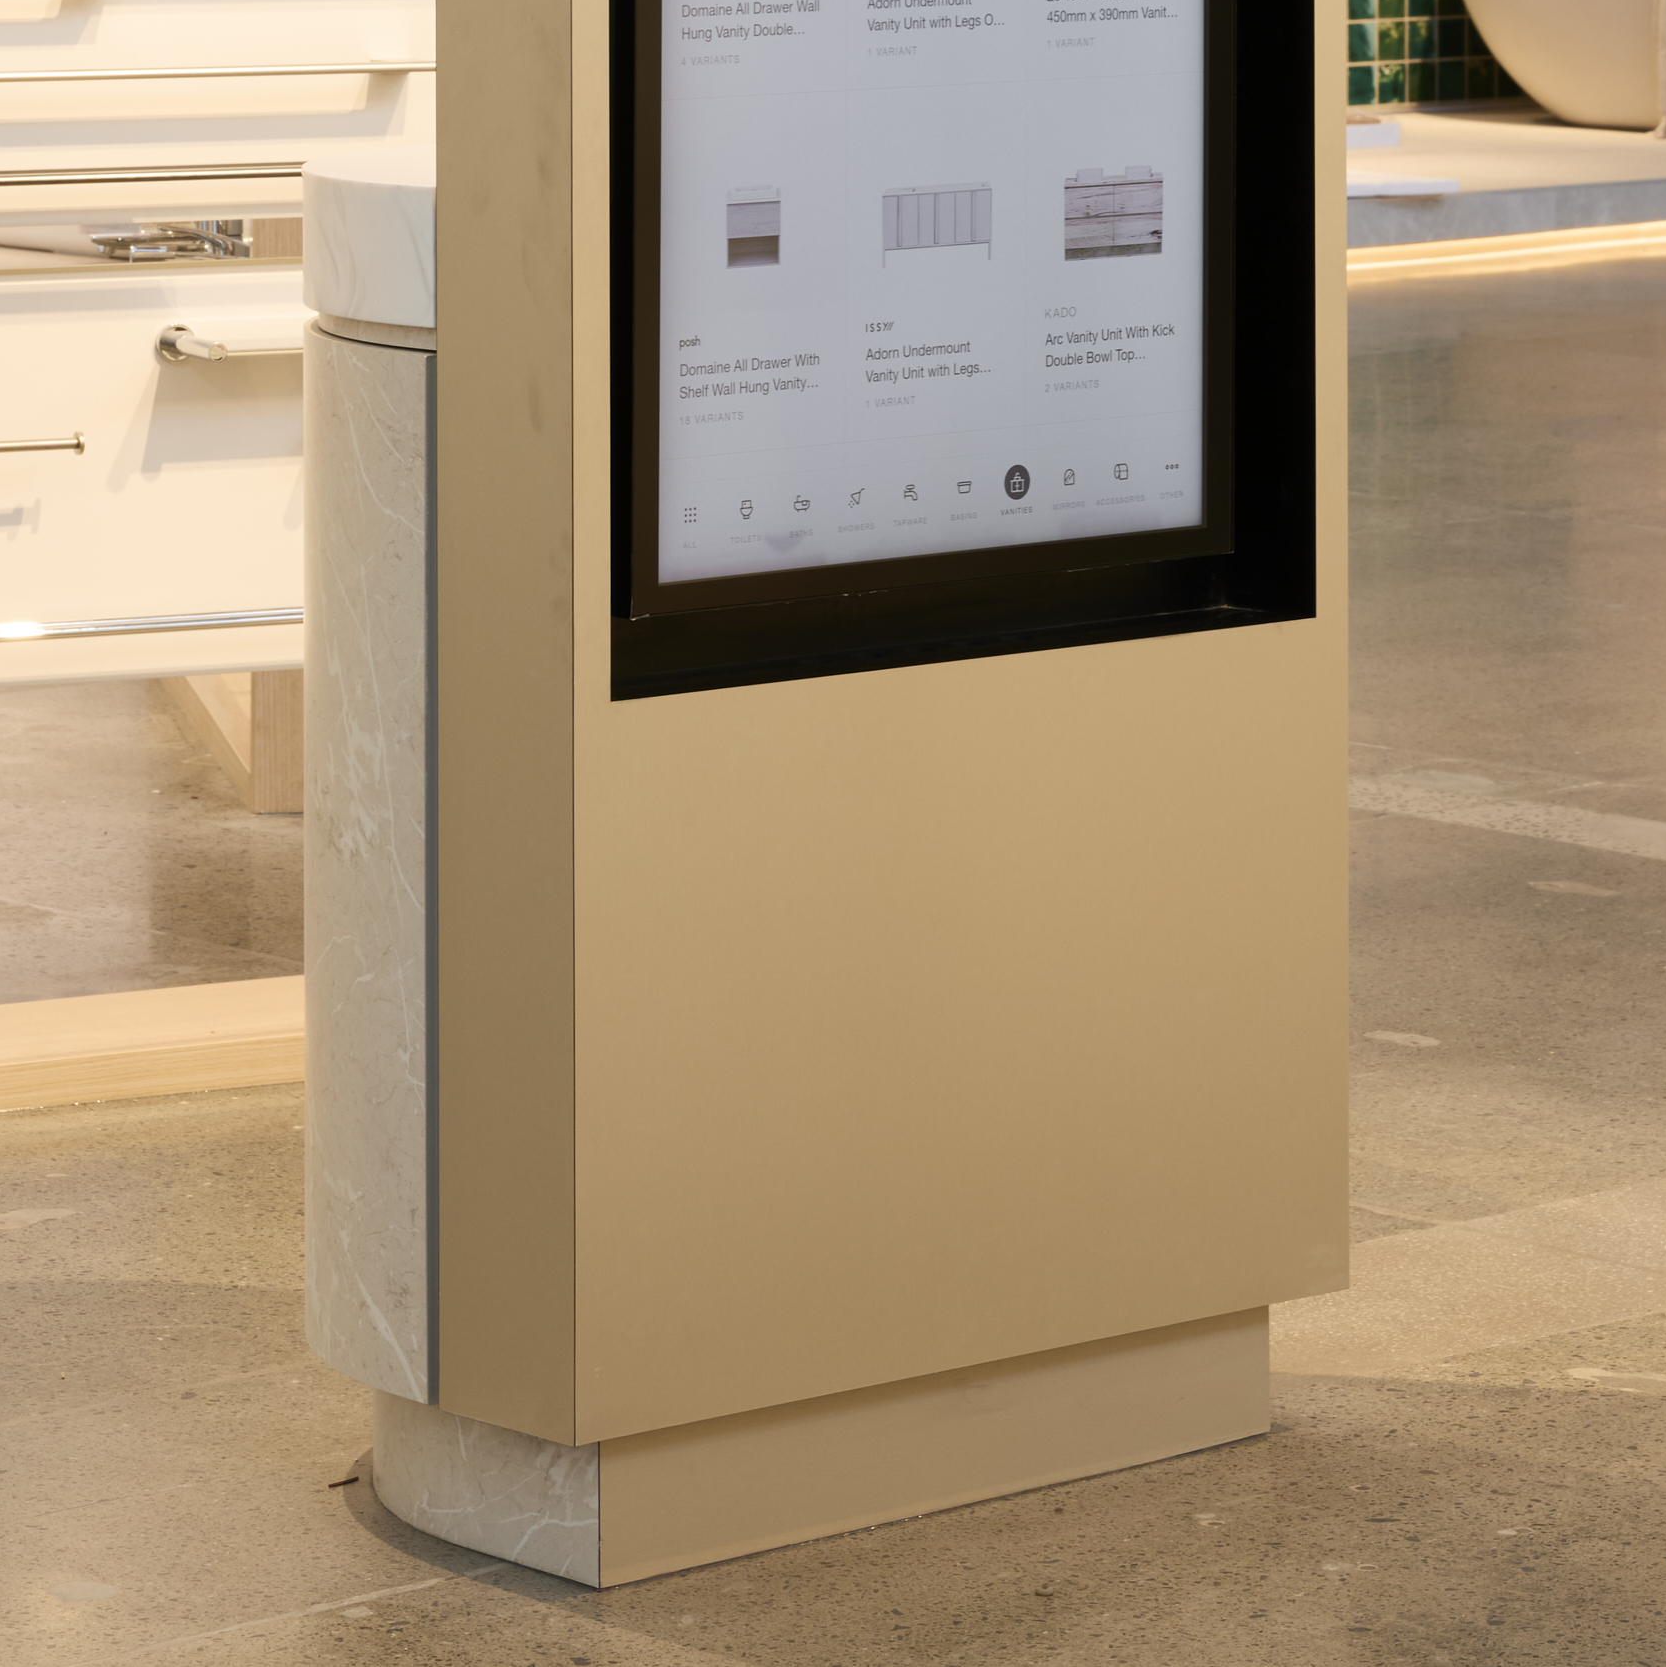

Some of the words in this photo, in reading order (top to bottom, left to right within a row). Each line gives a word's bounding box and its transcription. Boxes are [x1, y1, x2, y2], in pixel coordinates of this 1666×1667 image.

[682, 4, 732, 18] Domaine
[735, 2, 750, 15] All
[753, 1, 793, 14] Drawer
[796, 0, 820, 12] Wall
[1047, 10, 1087, 23] 450mm
[1090, 12, 1096, 21] x
[1099, 8, 1138, 20] 390mm
[867, 19, 900, 34] Vanity
[904, 17, 926, 30] Unit
[930, 16, 952, 28] with
[955, 14, 982, 31] Legs
[682, 27, 712, 42] Hung
[715, 25, 750, 41] Vanity
[1055, 38, 1095, 48] VARIANT
[876, 46, 917, 57] VARIANT
[681, 57, 686, 66] 4
[691, 55, 740, 65] VARIANTS
[1045, 307, 1077, 318] KADO
[1045, 333, 1063, 345] Arc
[1066, 330, 1098, 345] Vanity
[1101, 329, 1123, 341] Unit
[1125, 327, 1149, 339] With
[1152, 324, 1175, 337] Kick
[679, 336, 701, 350] posh
[865, 347, 900, 361] Adorn
[903, 341, 970, 358] Undermount
[1046, 353, 1083, 367] Double
[1086, 351, 1113, 364] Bowl
[680, 362, 730, 377] Domaine
[734, 360, 748, 372] All
[751, 357, 791, 371] Drawer
[795, 354, 820, 367] With
[865, 369, 899, 384] Vanity
[902, 366, 924, 380] Unit
[927, 364, 950, 377] with
[680, 386, 709, 399] Shelf
[712, 383, 736, 396] Wall
[740, 381, 770, 395] Hung
[1045, 383, 1050, 392] 2
[1054, 380, 1100, 391] VARIANTS
[875, 396, 915, 407] VARIANT
[694, 412, 744, 424] VARIANTS
[1095, 494, 1145, 506] ACCESSORIES
[1159, 490, 1184, 500] OTHER
[1001, 506, 1033, 516] VANITIES
[1053, 500, 1085, 511] MIRRORS
[893, 517, 928, 527] TAPWARE
[951, 512, 977, 522] BASINS
[838, 522, 875, 533] SHOWERS
[730, 534, 762, 544] TOILETS
[789, 529, 814, 538] BATHS
[683, 541, 697, 549] ALL
